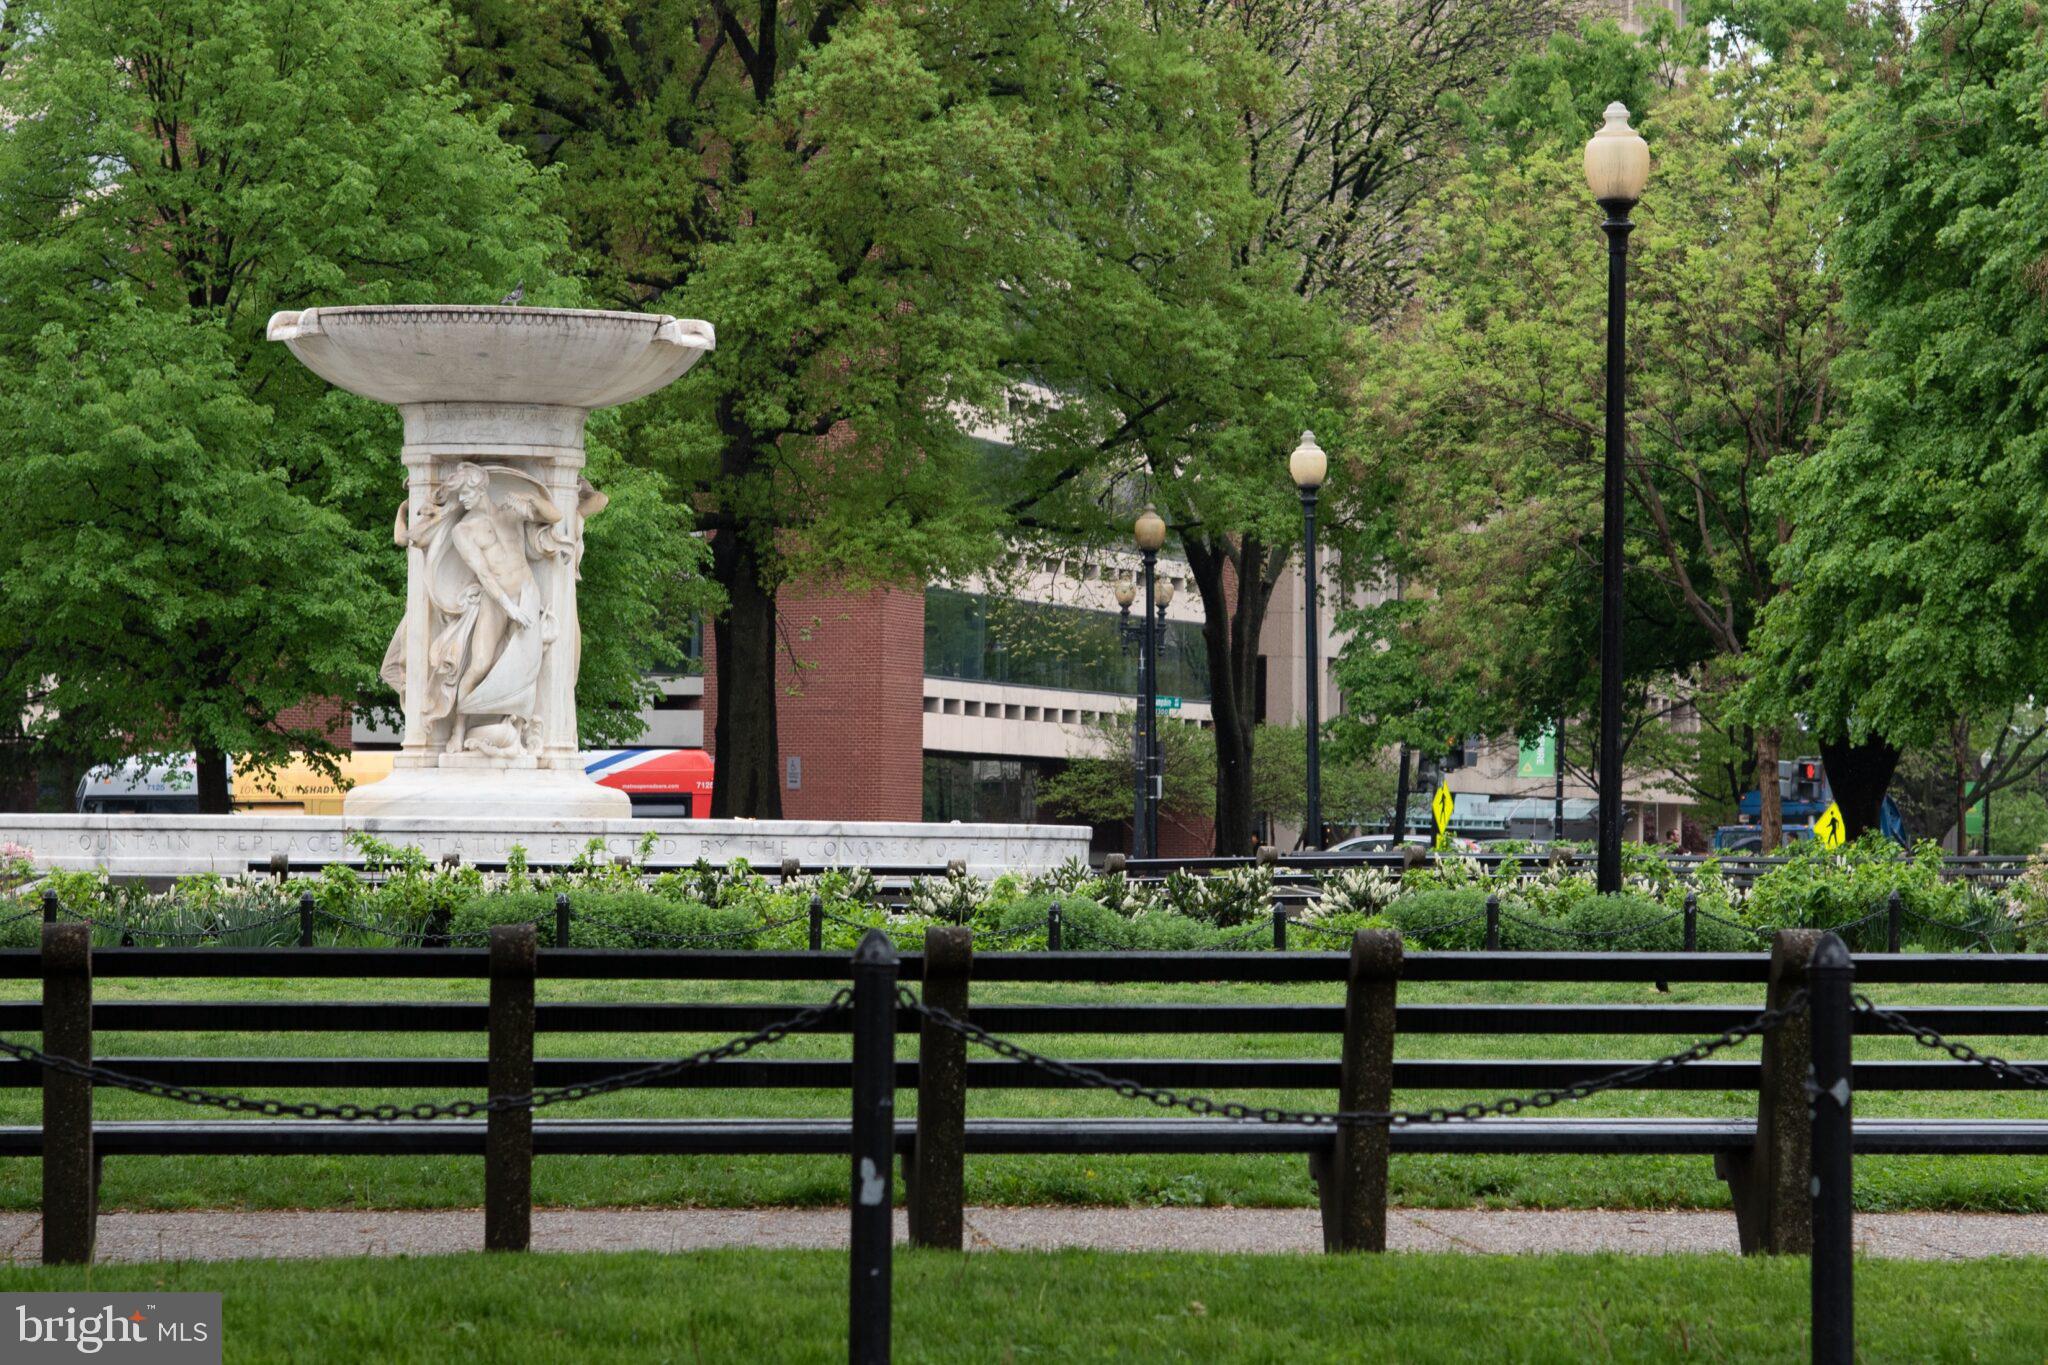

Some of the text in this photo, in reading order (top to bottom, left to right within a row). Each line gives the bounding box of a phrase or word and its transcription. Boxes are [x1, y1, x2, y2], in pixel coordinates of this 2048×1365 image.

[303, 786, 336, 794] SHADY
[67, 834, 191, 851] FOUNTAIN
[549, 838, 677, 856] ERCTD
[699, 840, 730, 856] BY
[746, 840, 789, 858] THE
[806, 841, 921, 859] CONGRESS
